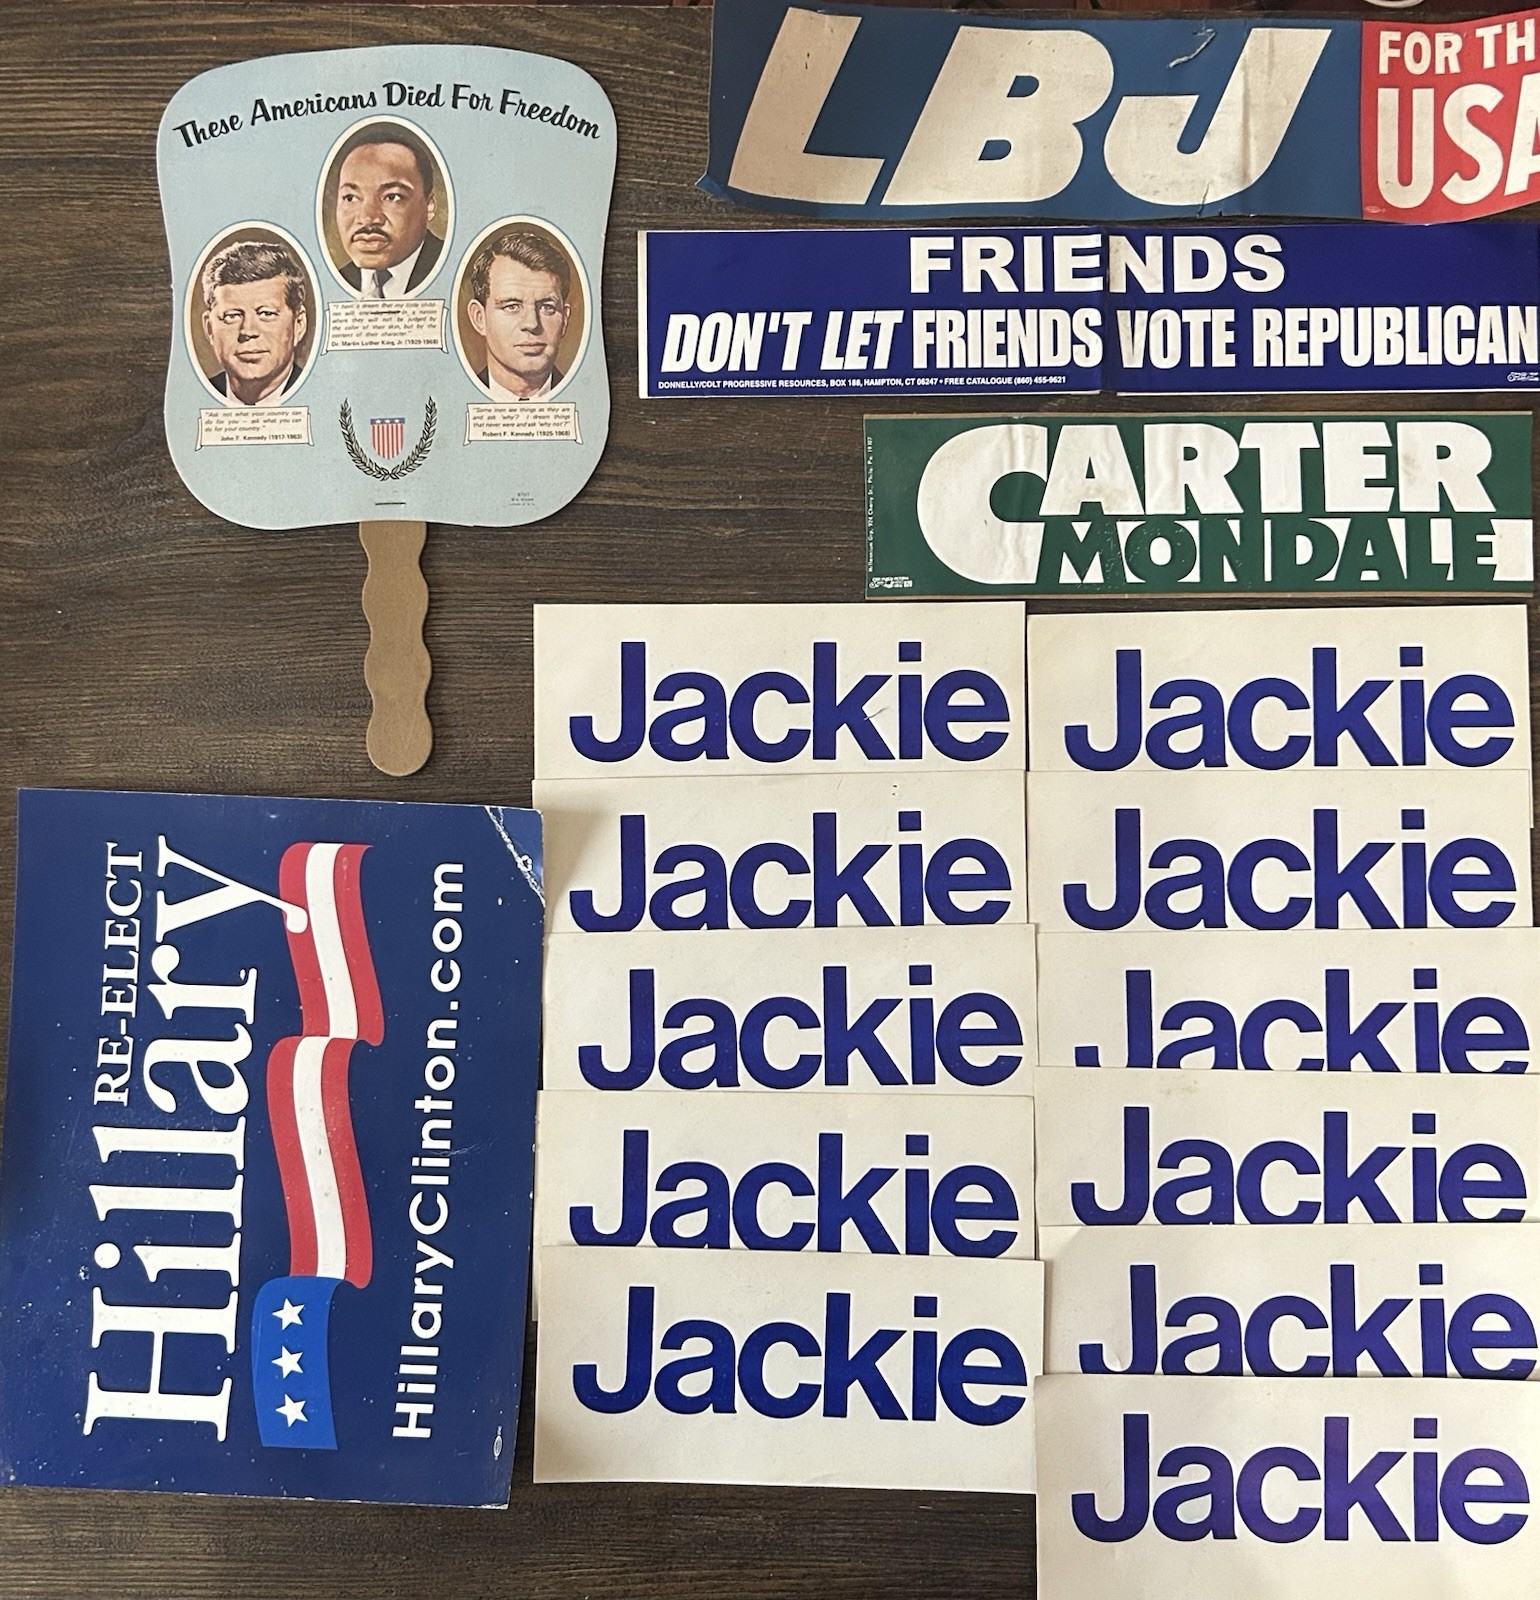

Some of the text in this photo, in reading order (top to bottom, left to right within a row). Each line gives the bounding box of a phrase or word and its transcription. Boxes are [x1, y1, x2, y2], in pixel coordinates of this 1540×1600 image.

[728, 7, 1332, 206] LBJ
[1379, 31, 1463, 74] FOR
[172, 82, 601, 148] These Americans Died For Freedom
[1377, 70, 1540, 209] USA
[909, 233, 1285, 294] FRIENDS
[658, 380, 720, 390] DONNELLY/COLT
[722, 380, 778, 388] PROGRESSIVE
[778, 379, 829, 388] RESOURCES,
[830, 379, 847, 387] BOX
[864, 378, 904, 388] HAMPTON,
[904, 378, 915, 386] CT
[916, 378, 938, 386] 06247
[944, 378, 964, 386] FREE
[966, 377, 1013, 385] CATALOGUE
[1014, 376, 1033, 386] (860)
[1034, 376, 1066, 384] 455-9621
[659, 305, 1539, 373] DON'T LET FRIENDS VOTE REPUBLICAN
[867, 497, 875, 516] Cherry
[917, 421, 1497, 584] CARTER
[1036, 518, 1497, 583] MONDALE
[571, 643, 1006, 759] Jackie
[1066, 649, 1512, 768] Jackie
[570, 813, 1009, 931] Jackie
[1065, 810, 1513, 928] Jackie
[93, 842, 145, 1106] RE-ELECT
[579, 967, 1020, 1088] Jackie
[1076, 970, 1527, 1072] Jackie
[83, 835, 308, 1442] Hillary
[392, 862, 465, 1439] HillaryClinton.com
[570, 1131, 1016, 1256] Jackie
[1072, 1109, 1525, 1223] Jackie
[574, 1288, 1026, 1424] Jackie
[1080, 1265, 1536, 1374] Jackie
[1075, 1416, 1527, 1543] Jackie
